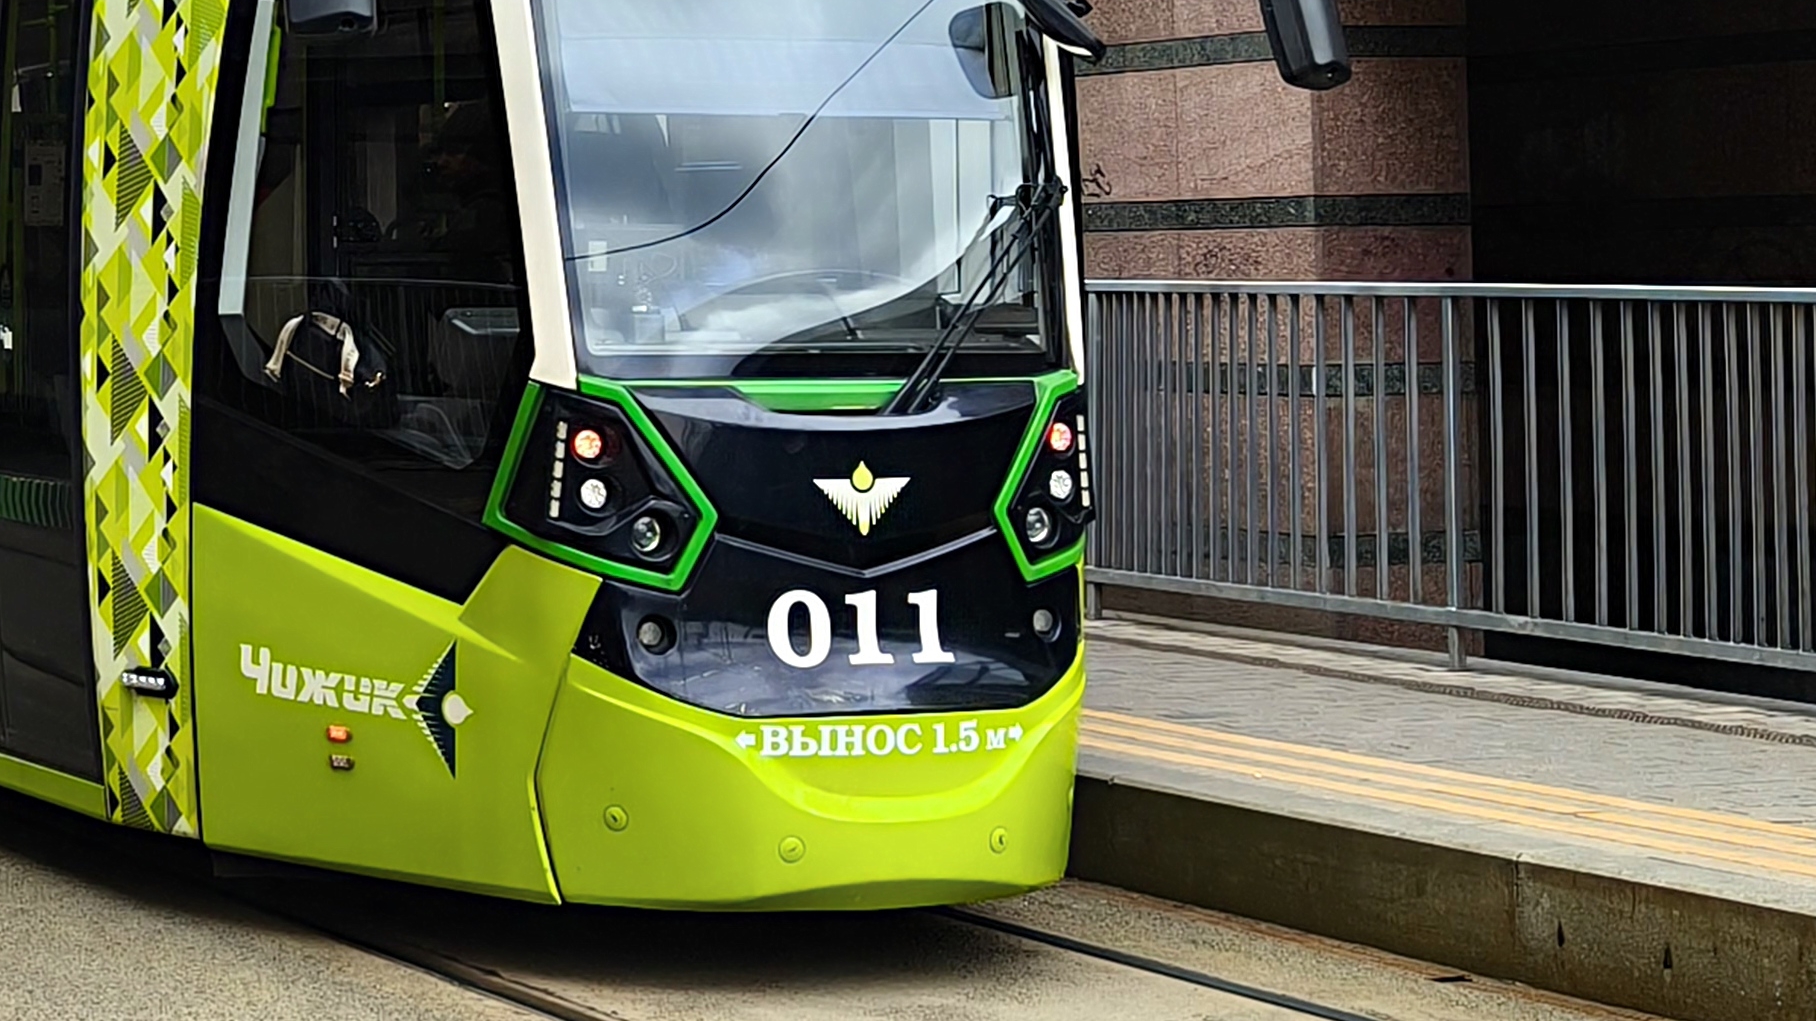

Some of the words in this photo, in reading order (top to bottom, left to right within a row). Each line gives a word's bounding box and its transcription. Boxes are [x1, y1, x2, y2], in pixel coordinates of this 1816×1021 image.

[767, 589, 956, 668] 011
[760, 724, 923, 757] ВЫНОС
[932, 720, 980, 754] 1.5
